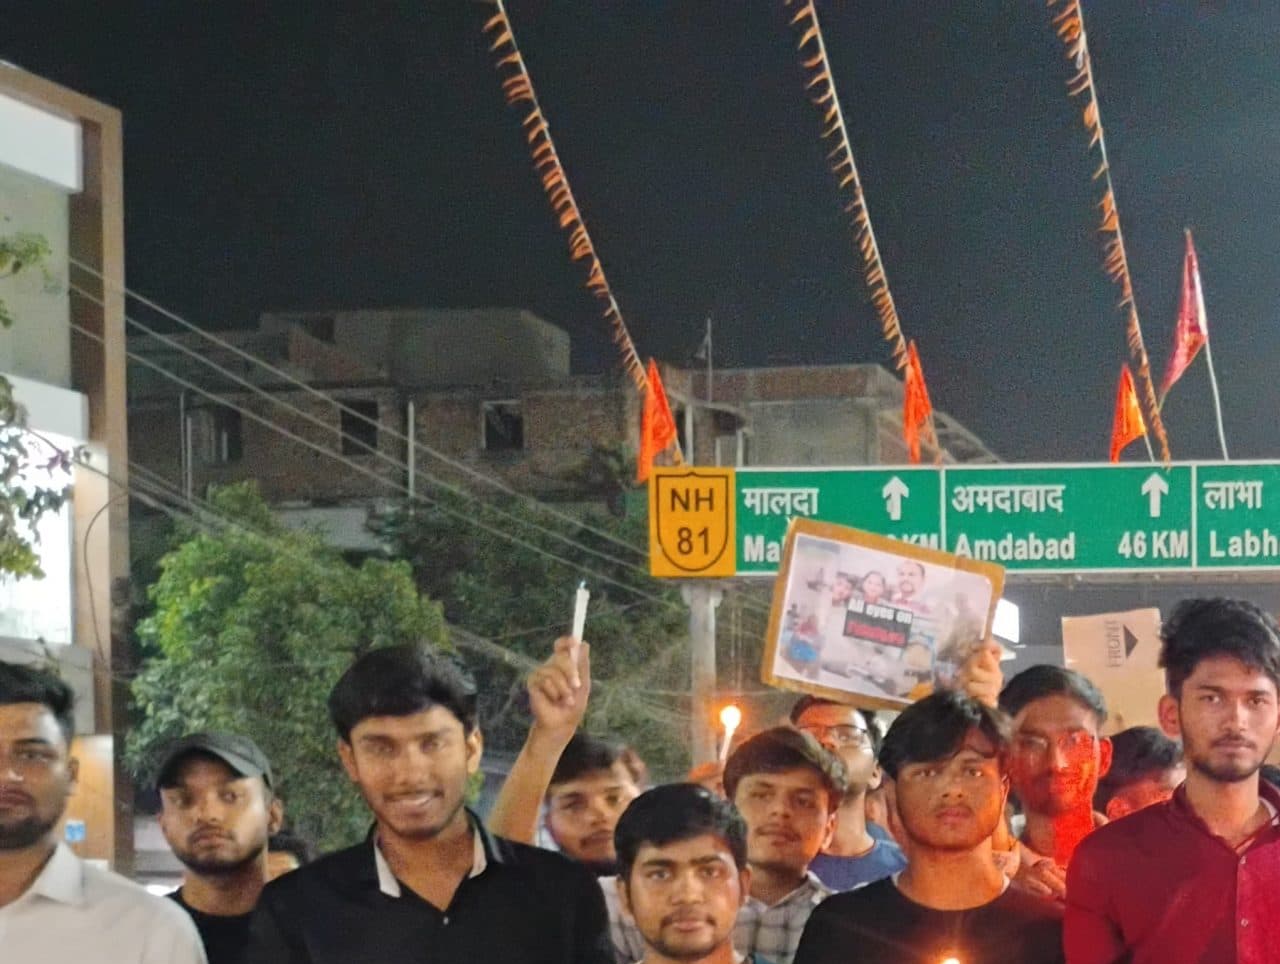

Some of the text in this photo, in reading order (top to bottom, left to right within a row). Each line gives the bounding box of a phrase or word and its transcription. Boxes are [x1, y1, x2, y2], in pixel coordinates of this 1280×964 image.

[670, 487, 715, 512] NH
[741, 487, 819, 516] मालदा
[951, 484, 1066, 514] अमदाबाद
[1202, 480, 1264, 510] लाभा
[676, 526, 711, 556] 81
[954, 529, 1190, 561] Amdabad 46 KM
